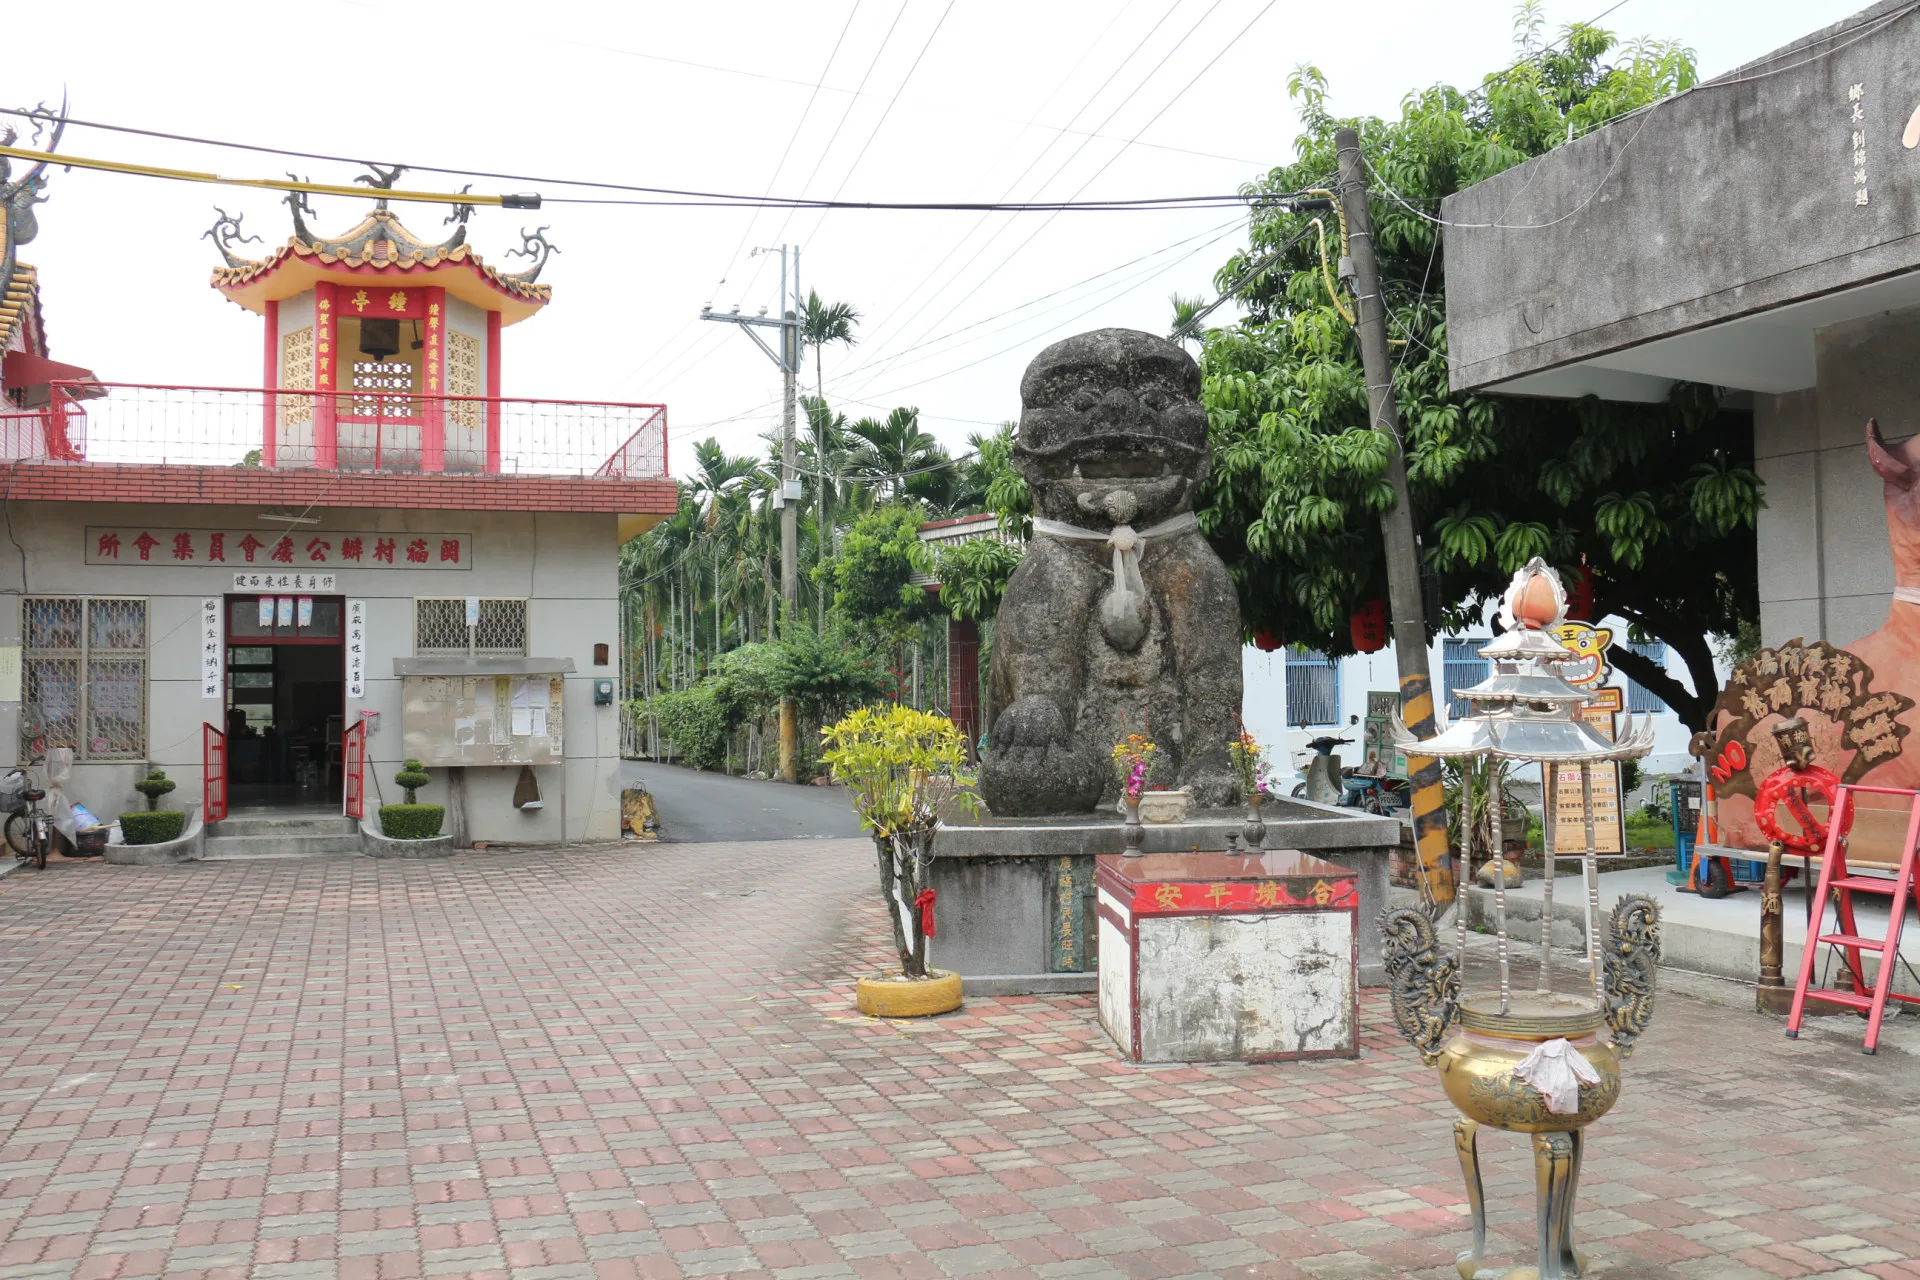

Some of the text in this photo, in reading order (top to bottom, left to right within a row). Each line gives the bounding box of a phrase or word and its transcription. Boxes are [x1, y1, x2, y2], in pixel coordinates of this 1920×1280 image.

[1561, 629, 1575, 641] 王
[1711, 740, 1746, 784] NO
[1154, 878, 1337, 910] 合境平安
